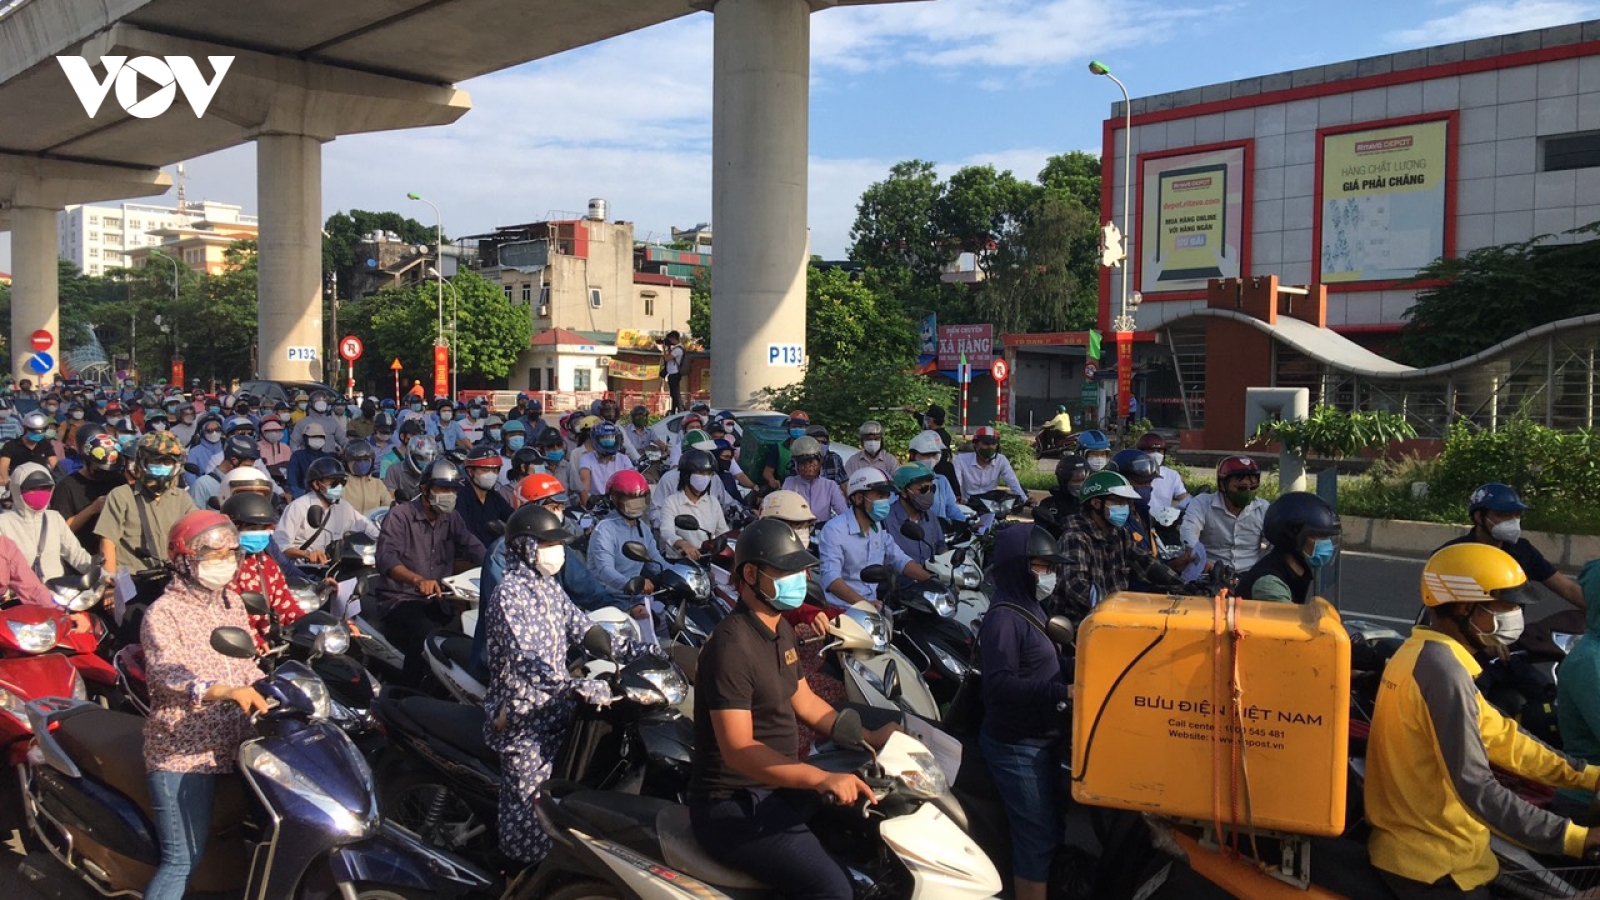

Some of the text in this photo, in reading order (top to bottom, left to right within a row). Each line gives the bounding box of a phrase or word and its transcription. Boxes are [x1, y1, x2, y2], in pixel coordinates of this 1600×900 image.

[1384, 138, 1411, 148] DEPOT
[1341, 158, 1427, 177] HÀNG CHẤT LƯỢNG
[1342, 173, 1425, 192] GIÁ PHẢI CHĂNG
[1196, 213, 1217, 222] ONLINE
[939, 334, 990, 354] XẢ HÀNG
[288, 348, 316, 360] P132
[769, 346, 802, 363] P133
[1134, 695, 1322, 726] BƯU ĐIỆN IỆT NAM
[1168, 718, 1186, 728] Call
[1188, 722, 1221, 732] cente:
[1249, 727, 1266, 737] 545
[1268, 728, 1285, 738] 481
[1168, 729, 1209, 741] Website:
